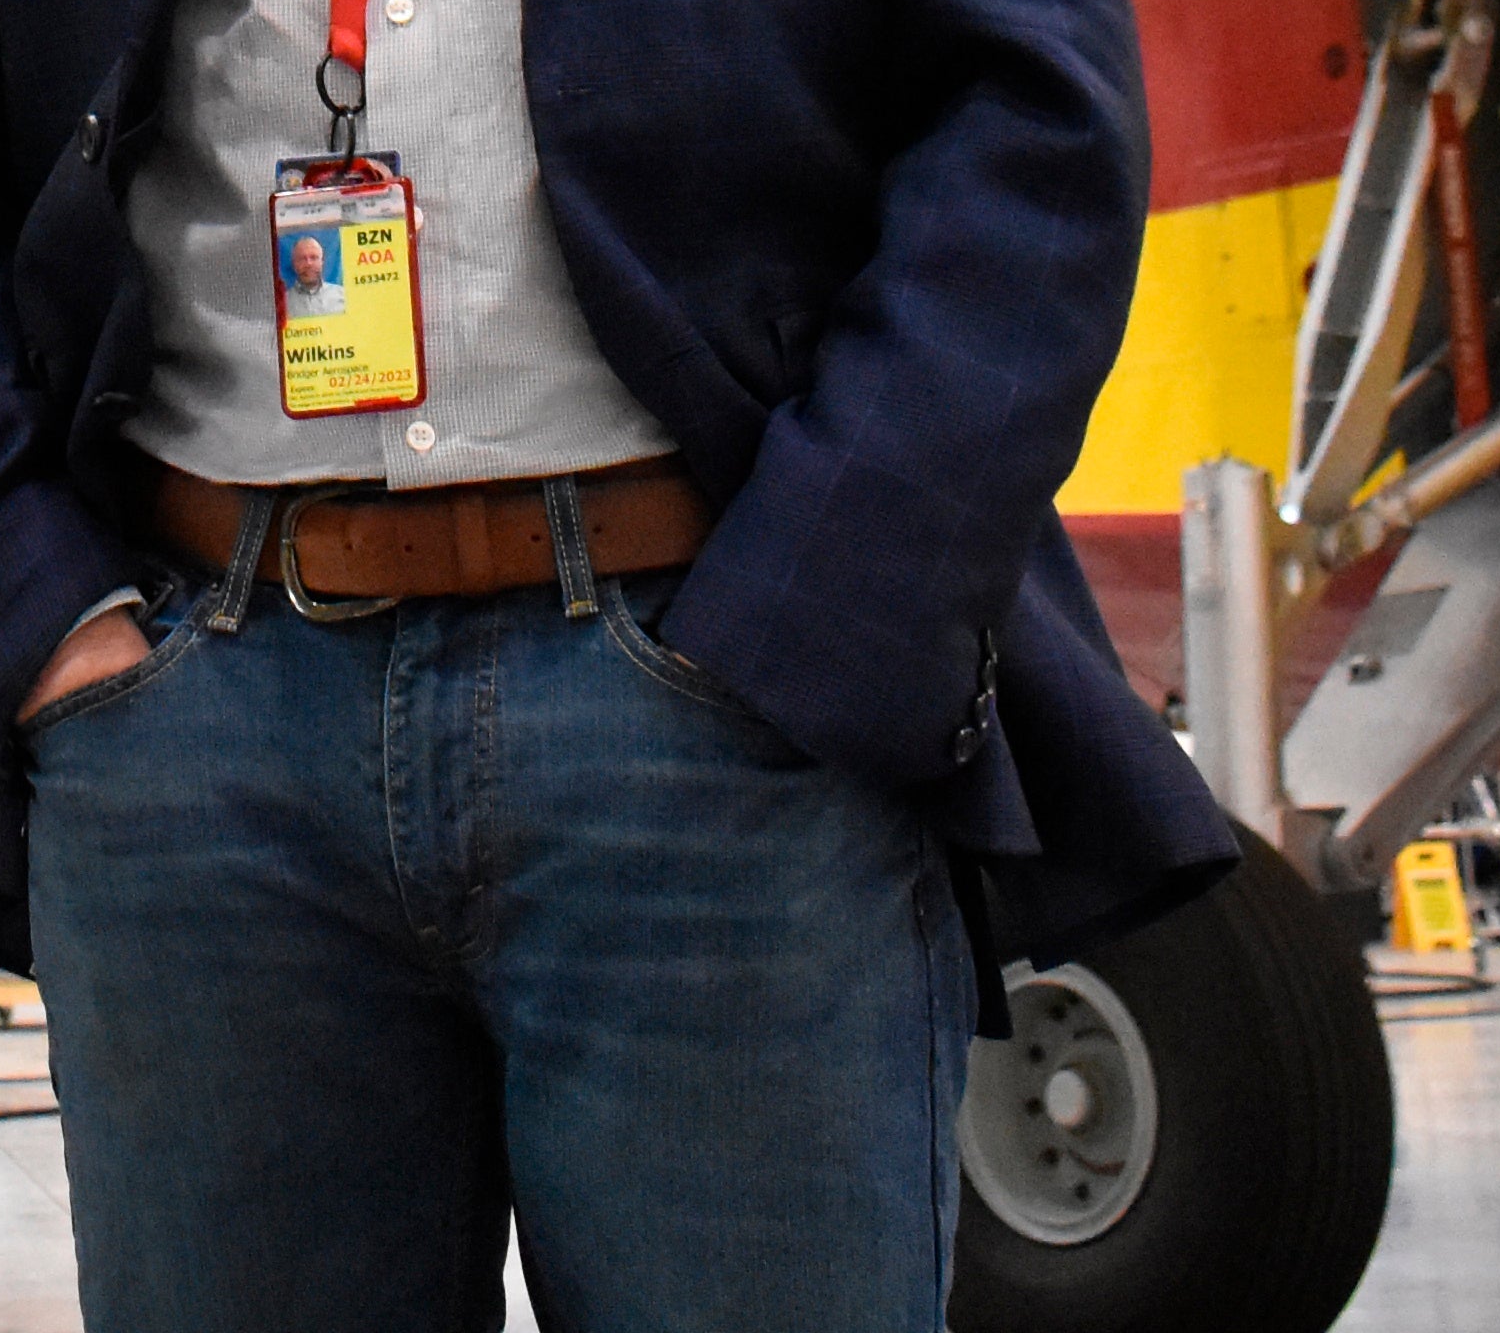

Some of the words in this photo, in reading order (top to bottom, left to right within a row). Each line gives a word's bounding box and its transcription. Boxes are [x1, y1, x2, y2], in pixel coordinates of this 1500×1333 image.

[357, 229, 392, 245] BZN
[357, 249, 394, 265] AOA
[285, 326, 322, 338] Darren
[286, 345, 355, 364] Wilkins
[329, 369, 411, 388] 02/24/2023
